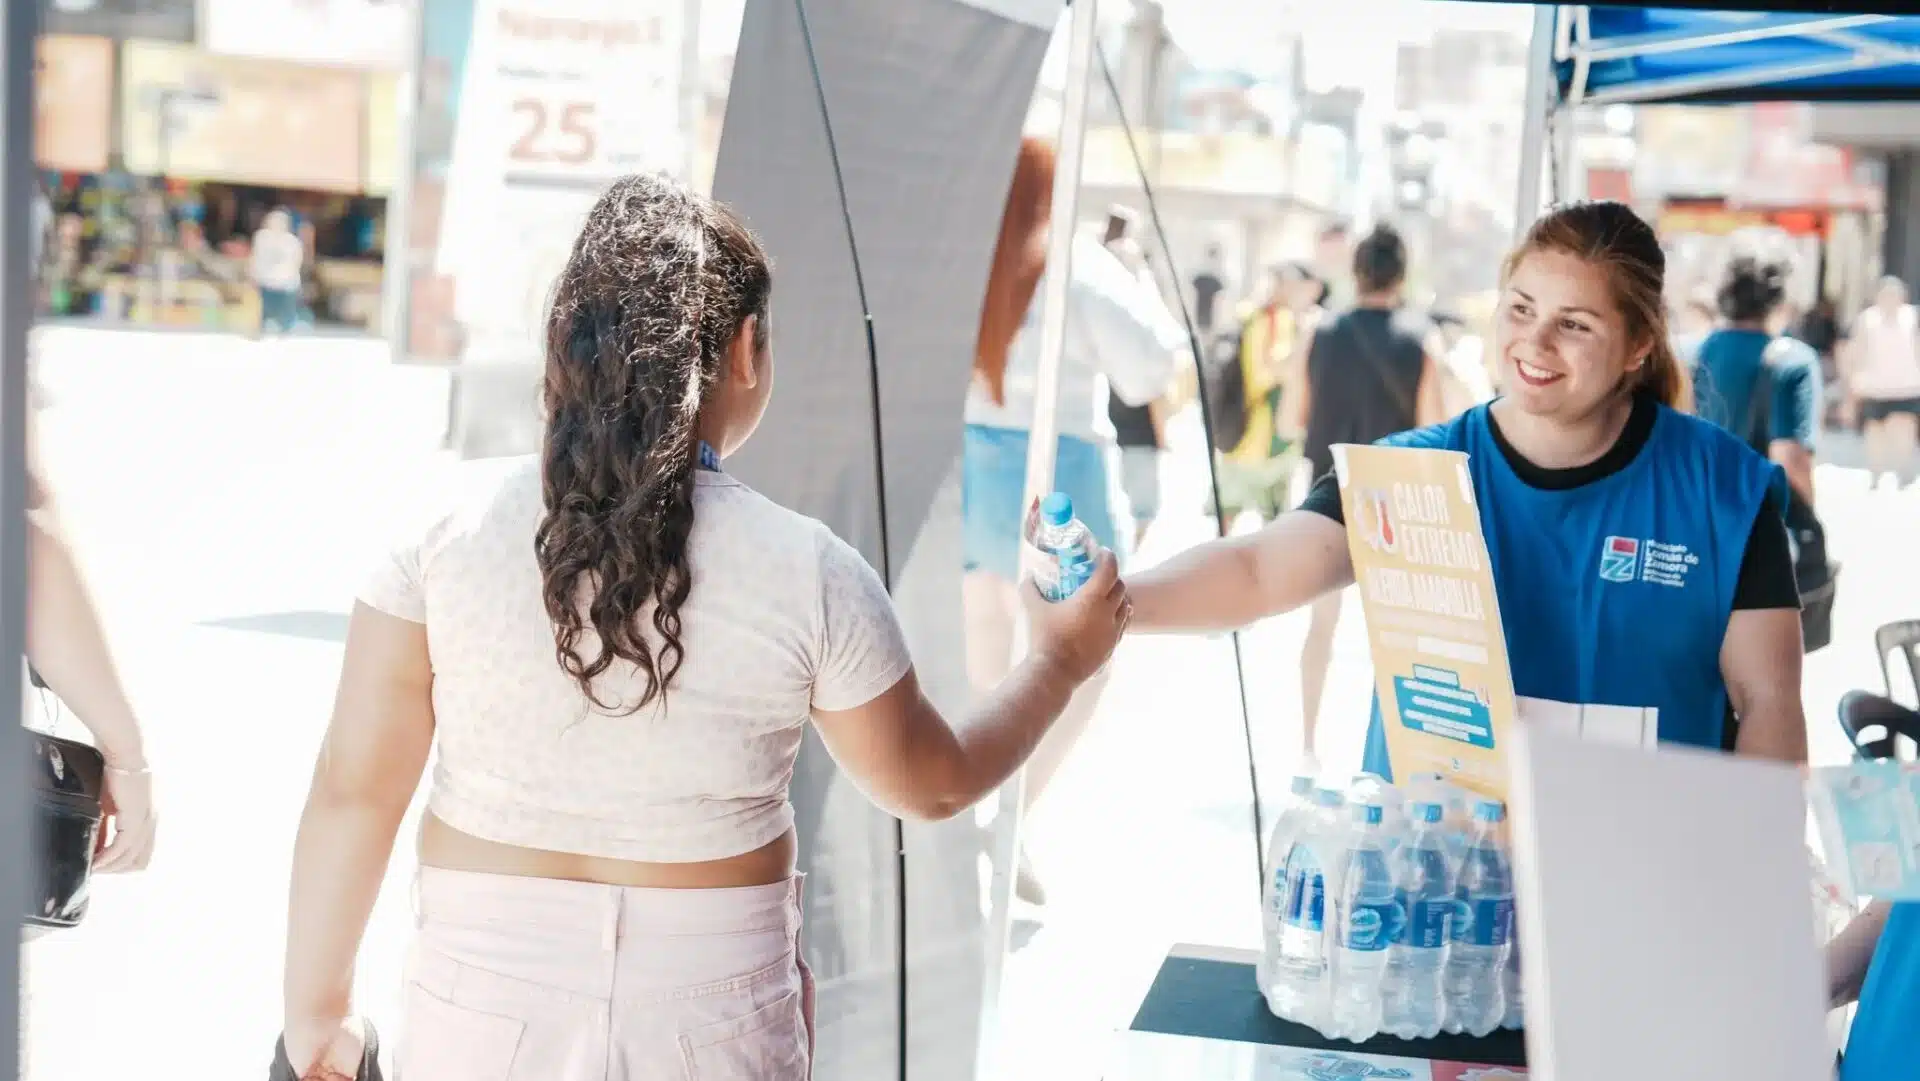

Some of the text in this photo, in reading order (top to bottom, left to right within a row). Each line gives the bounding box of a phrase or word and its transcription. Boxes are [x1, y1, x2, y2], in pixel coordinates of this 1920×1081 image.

[510, 99, 596, 164] 25
[1393, 482, 1450, 525] CALOR
[1401, 523, 1480, 572] EXTREMO
[1684, 553, 1699, 565] de
